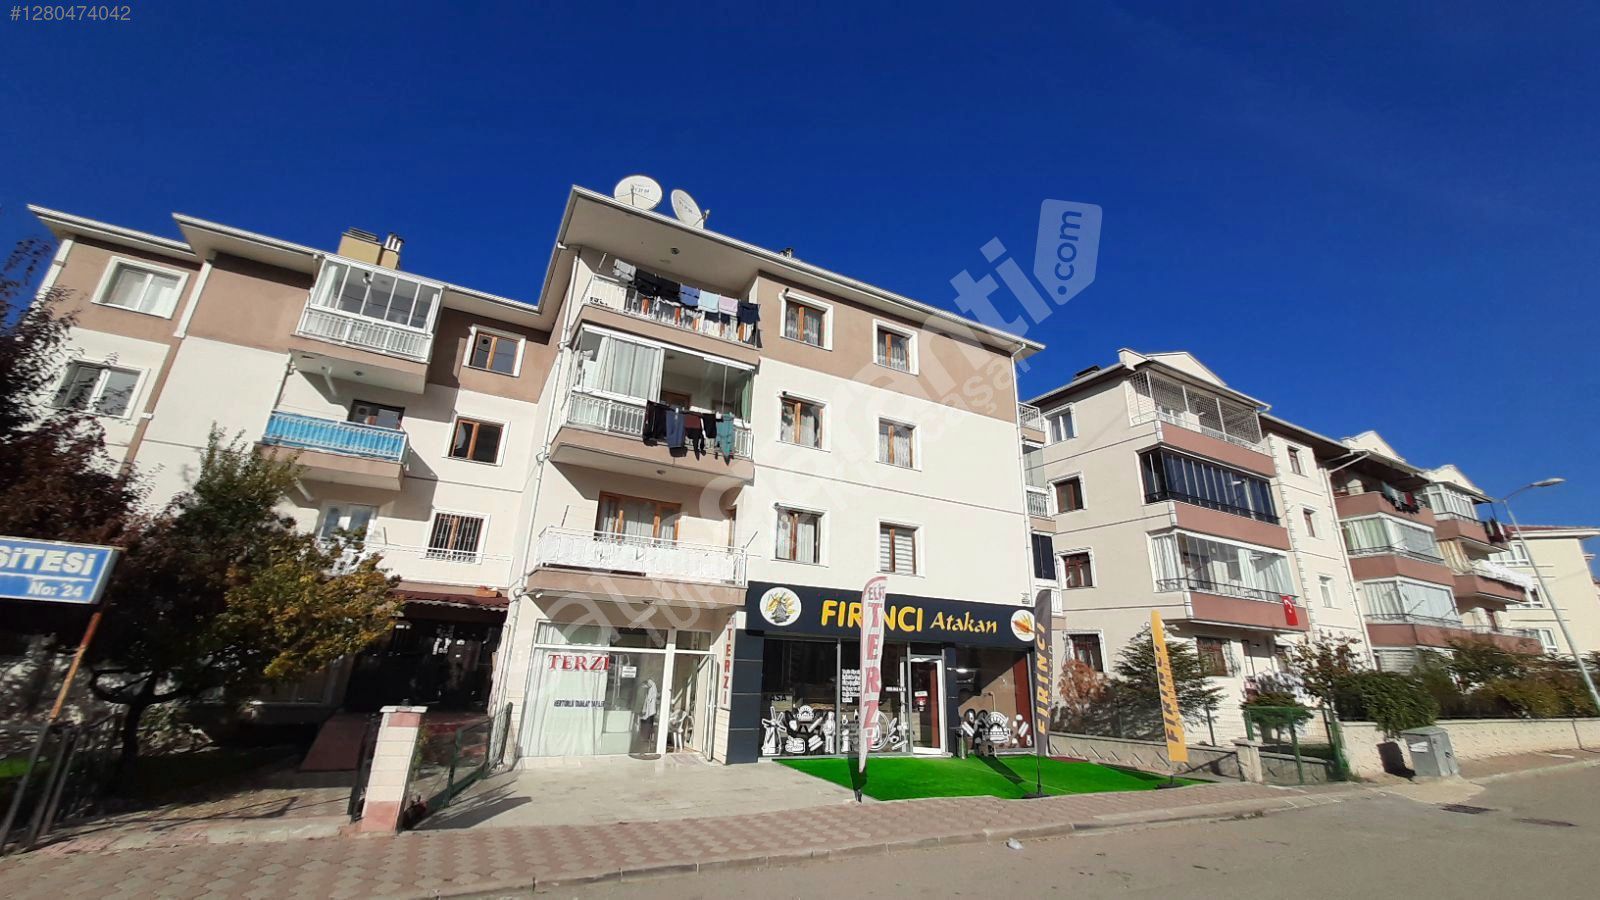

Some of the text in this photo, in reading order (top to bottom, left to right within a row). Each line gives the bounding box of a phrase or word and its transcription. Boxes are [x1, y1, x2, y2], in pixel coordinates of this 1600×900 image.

[820, 599, 998, 635] FIRNCI Atakan
[1036, 622, 1051, 735] FIRINCI
